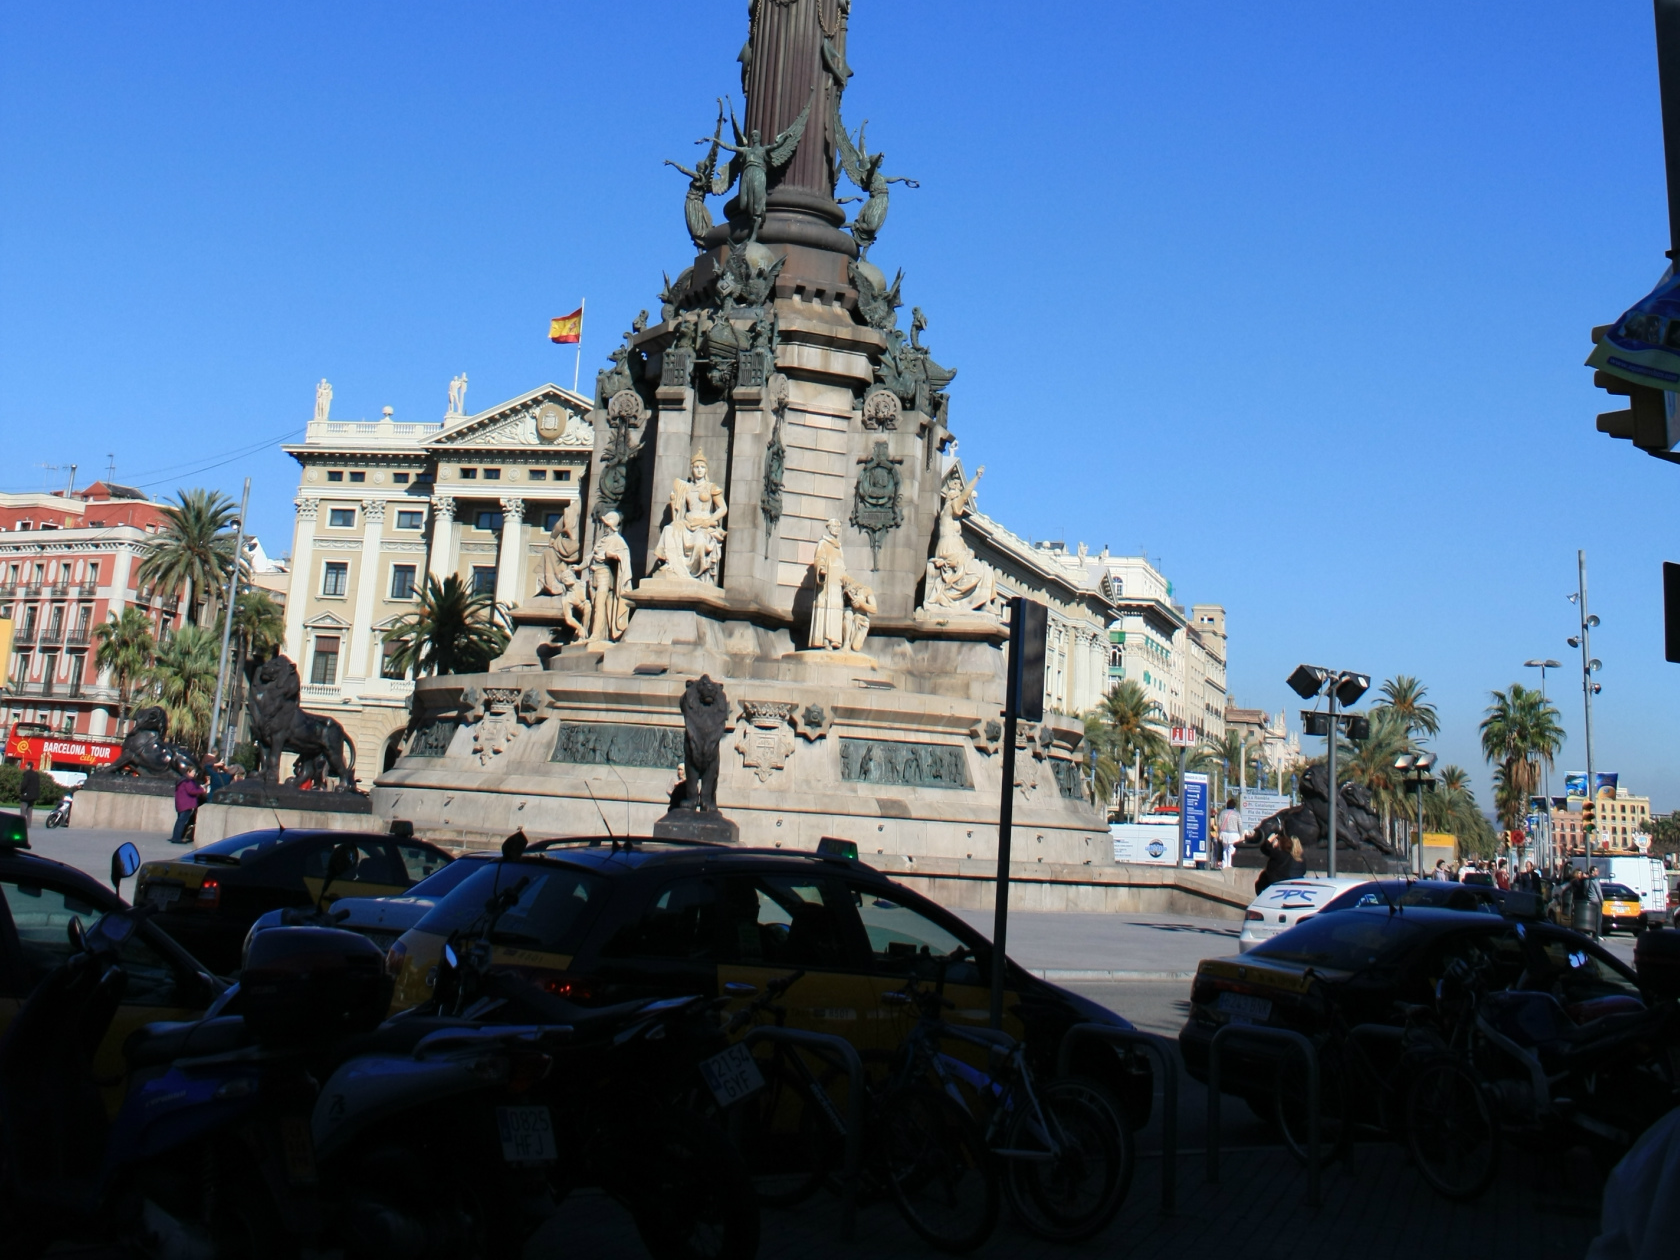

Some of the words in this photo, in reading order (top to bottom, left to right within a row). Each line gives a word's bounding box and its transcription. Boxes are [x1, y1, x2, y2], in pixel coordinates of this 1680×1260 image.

[43, 741, 86, 756] BARCELONA
[91, 746, 111, 759] TOUR
[79, 754, 97, 764] city
[711, 1045, 750, 1078] 2154
[723, 1069, 749, 1098] GYF
[510, 1110, 549, 1132] 0825
[514, 1134, 544, 1156] HFJ
